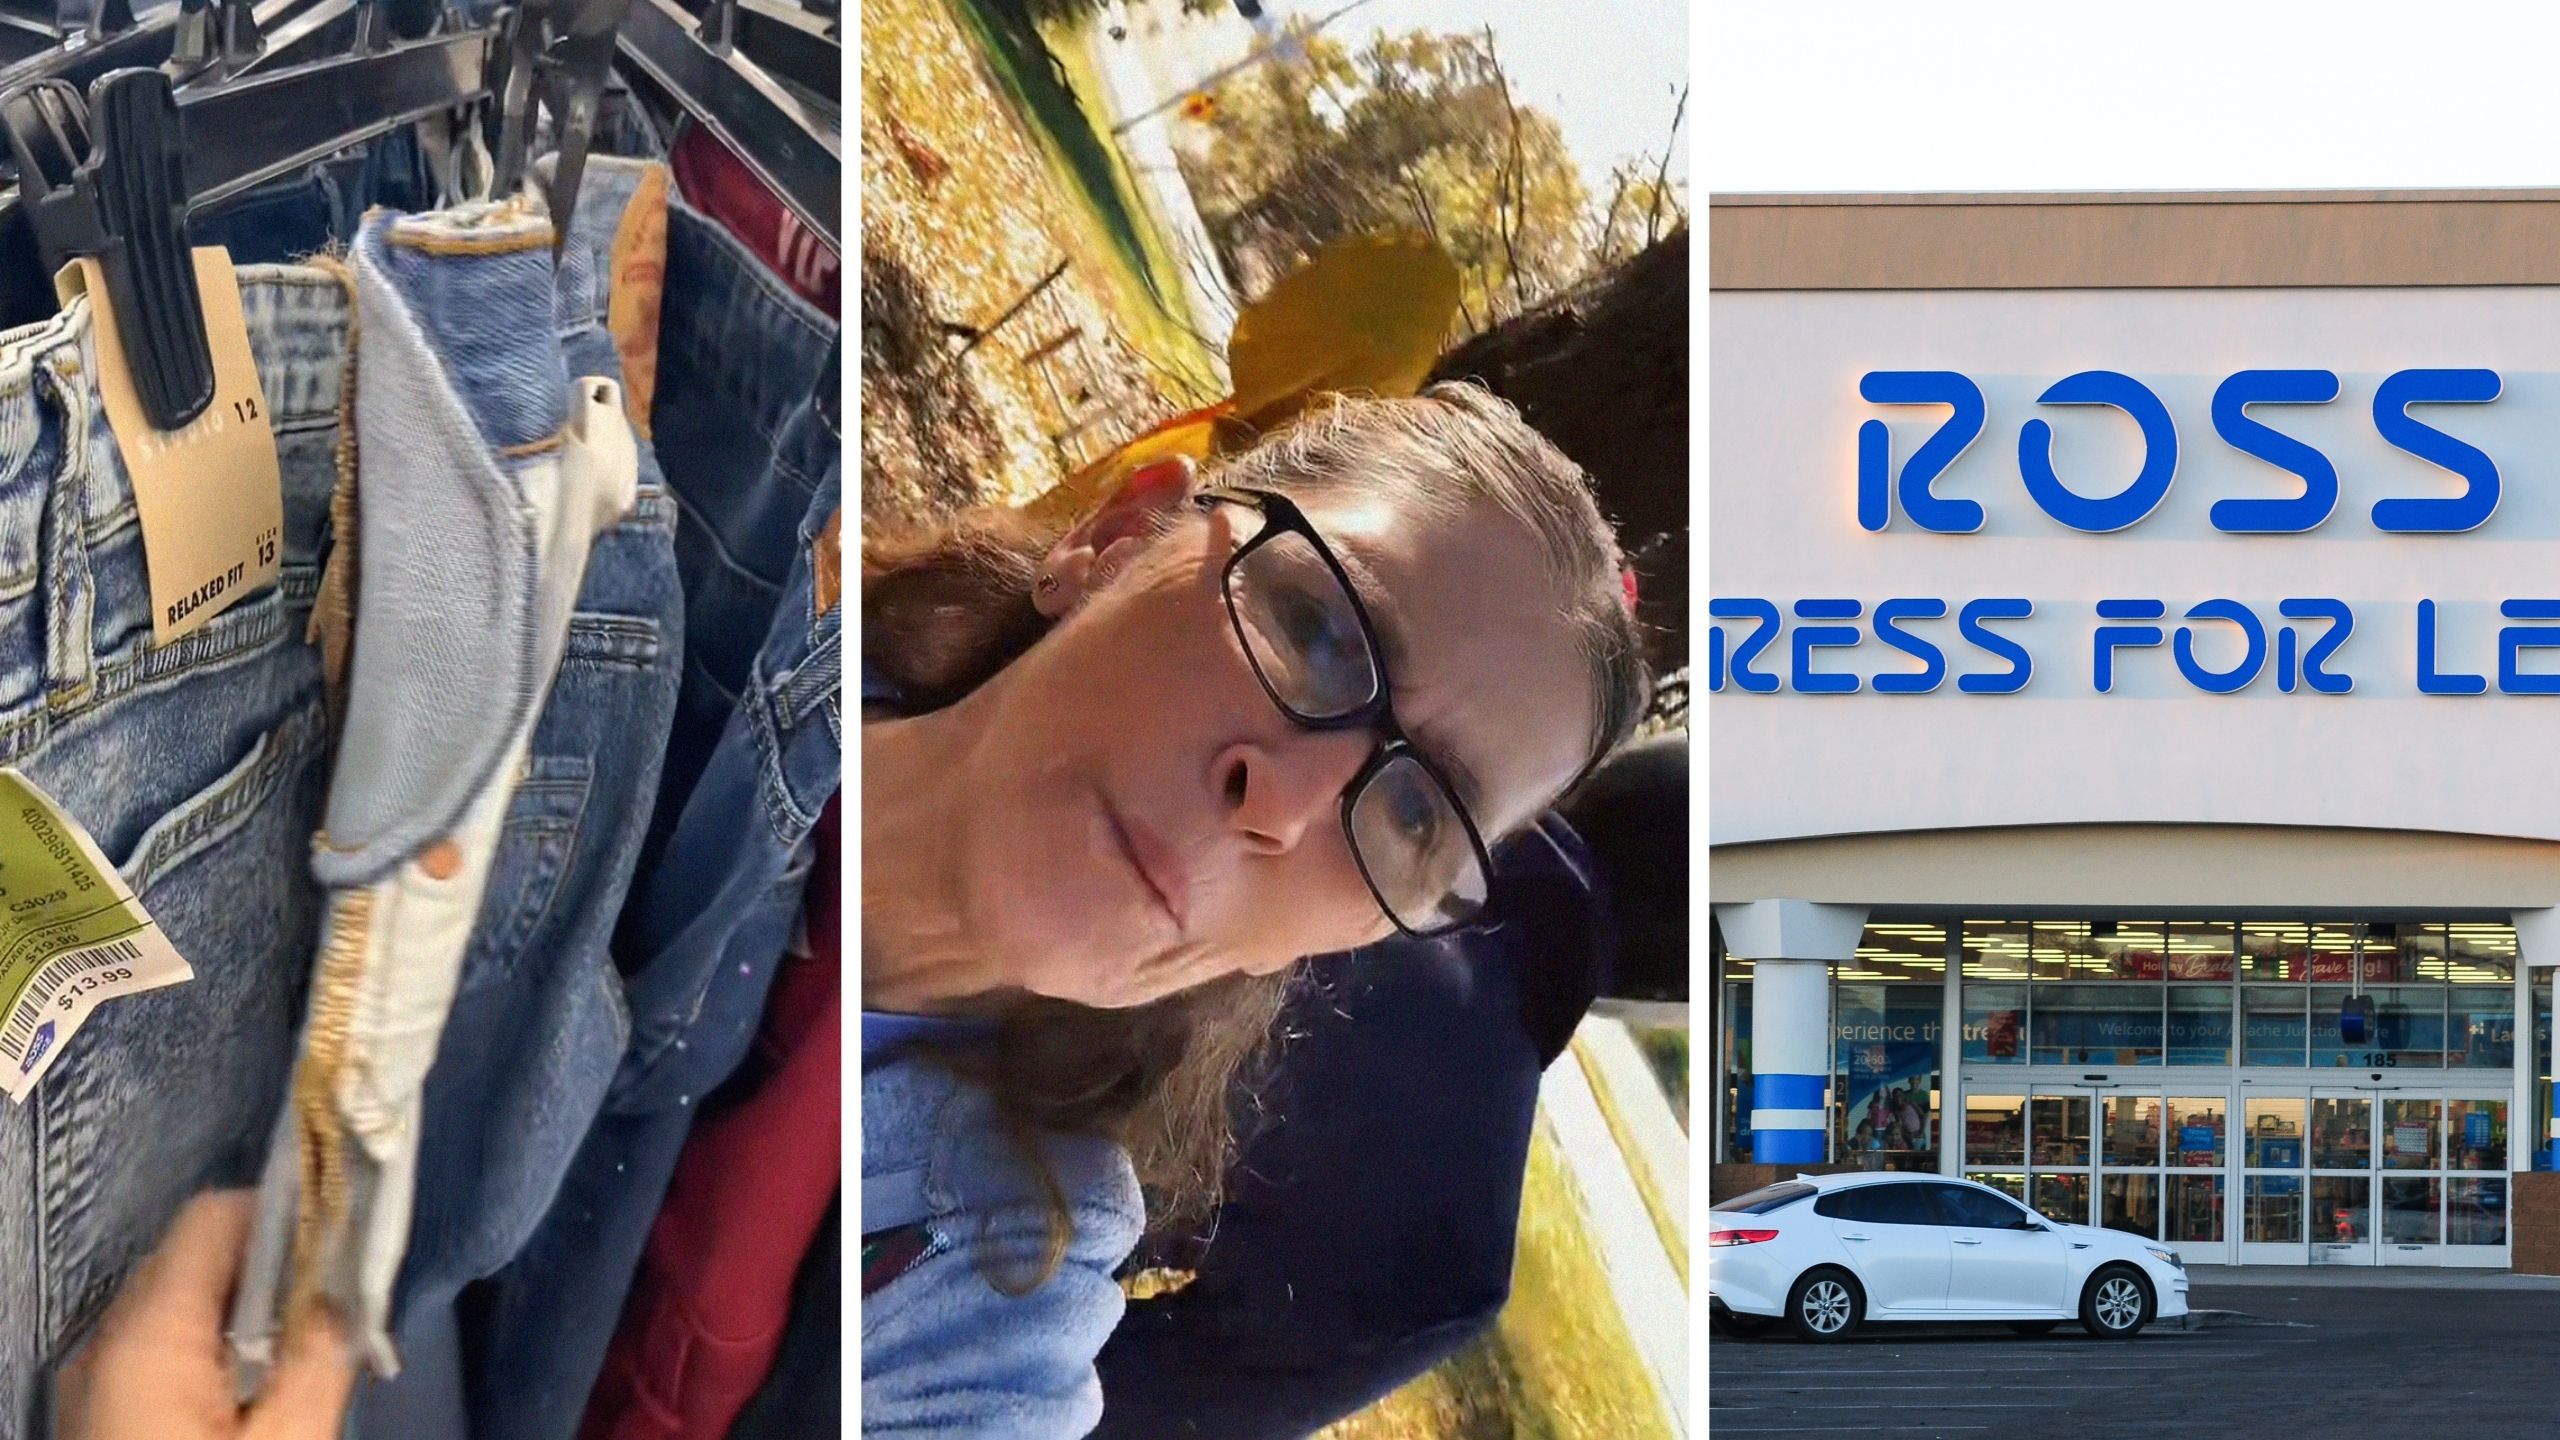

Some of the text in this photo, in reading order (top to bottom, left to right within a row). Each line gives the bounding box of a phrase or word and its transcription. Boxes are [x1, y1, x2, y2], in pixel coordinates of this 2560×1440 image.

[233, 397, 258, 423] 12
[1858, 368, 2504, 533] ROSS
[258, 541, 275, 568] 13
[167, 561, 245, 627] RELAXED FIT
[1709, 597, 2560, 695] RESS FOR LE
[22, 808, 96, 892] 400296811425
[25, 933, 80, 965] $19.99
[2142, 961, 2184, 974] Holay
[2347, 959, 2382, 977] Bg!
[58, 968, 132, 1012] $13.99
[1922, 1020, 1942, 1042] th
[2170, 1024, 2185, 1036] to
[2190, 1026, 2222, 1039] your
[2226, 1024, 2282, 1037] ache
[2363, 1053, 2397, 1067] 185
